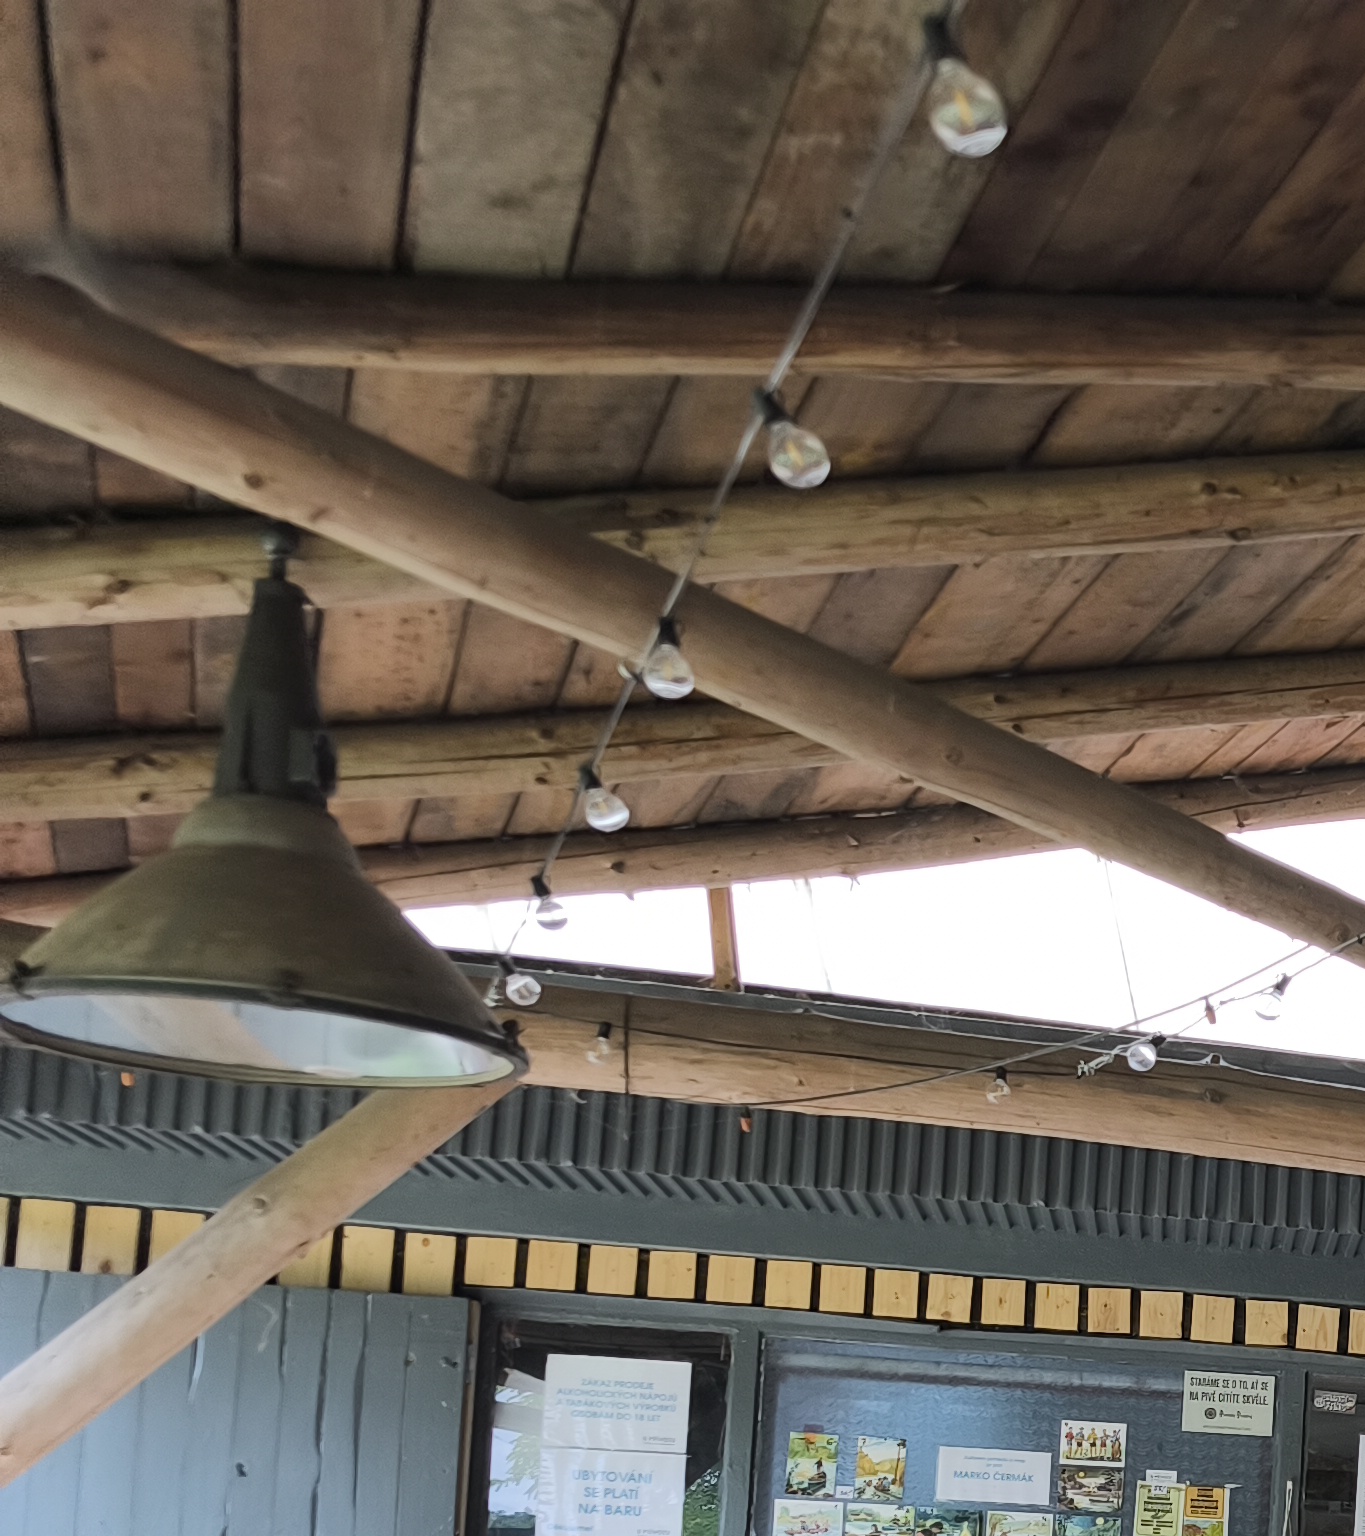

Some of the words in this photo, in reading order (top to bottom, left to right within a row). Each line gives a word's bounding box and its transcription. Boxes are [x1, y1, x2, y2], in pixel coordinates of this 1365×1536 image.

[1222, 1379, 1230, 1388] SE
[1261, 1382, 1269, 1391] SE
[1190, 1391, 1199, 1401] NA
[572, 1469, 652, 1484] UBYTOVÁNÍ
[954, 1470, 990, 1481] MARKO
[993, 1468, 1033, 1482] ČERMÁK
[584, 1487, 599, 1498] SE
[604, 1485, 639, 1499] PLATÍ
[578, 1504, 599, 1515] NA
[604, 1504, 642, 1516] BARU
